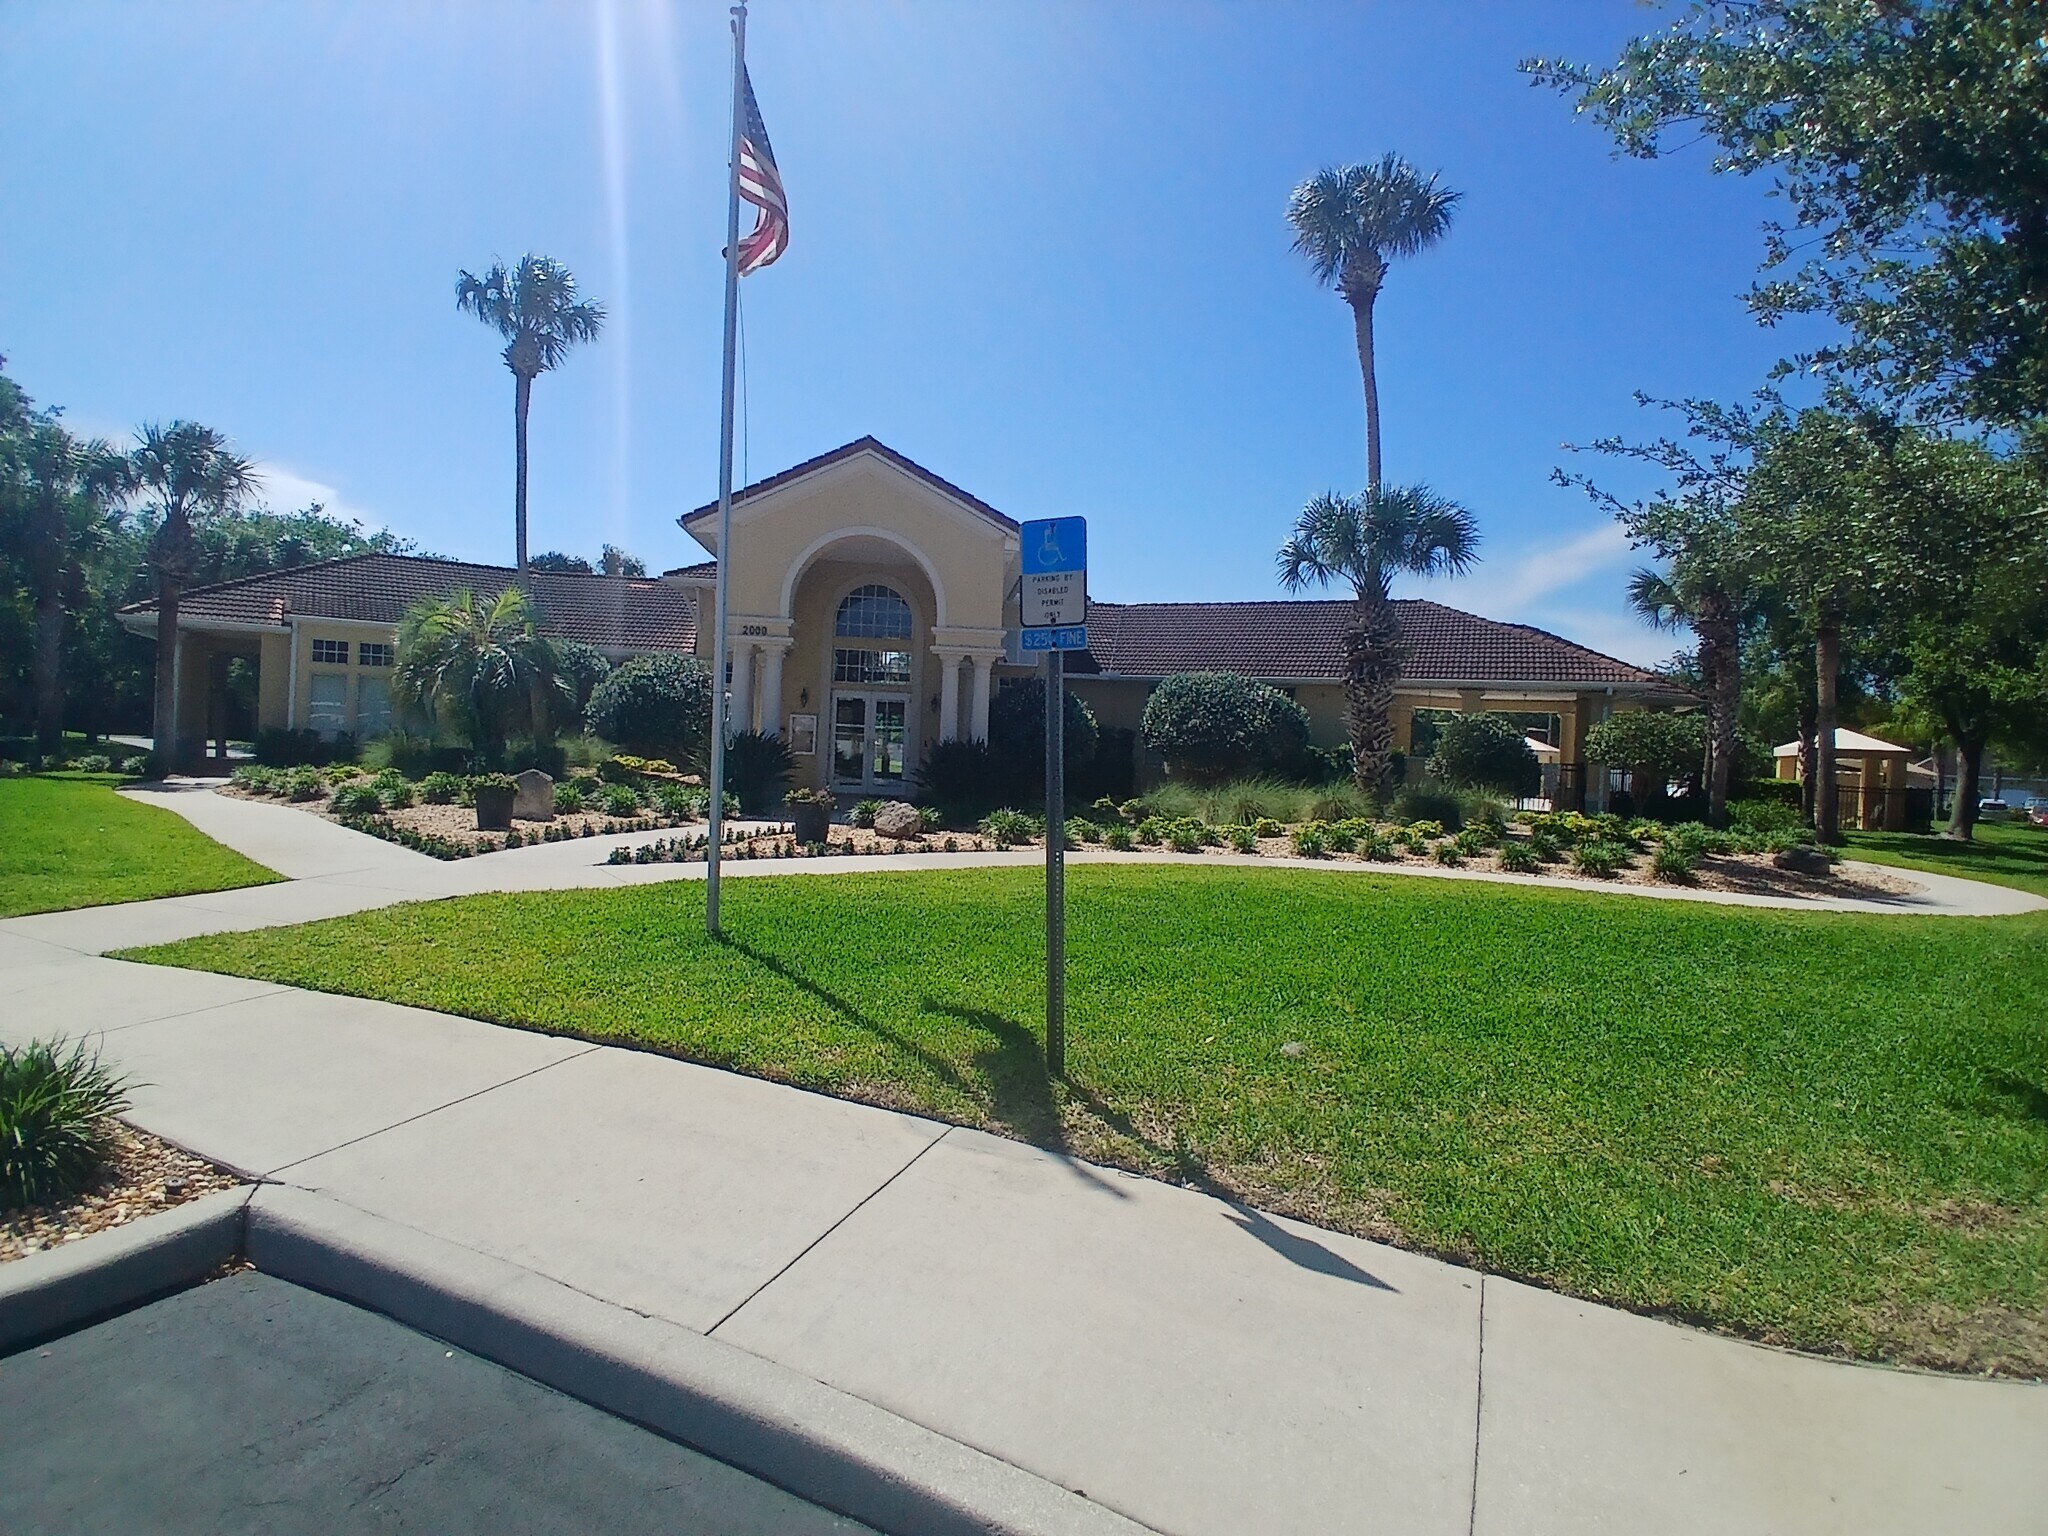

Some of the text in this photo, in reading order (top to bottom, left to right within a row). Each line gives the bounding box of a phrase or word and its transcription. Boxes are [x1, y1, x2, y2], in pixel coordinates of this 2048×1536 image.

[1032, 574, 1060, 583] PARKING
[1037, 586, 1069, 595] DISABLED
[1041, 598, 1064, 607] PERMIT
[1044, 611, 1061, 619] ONLY
[742, 625, 768, 636] 2000
[1060, 631, 1083, 645] FINE
